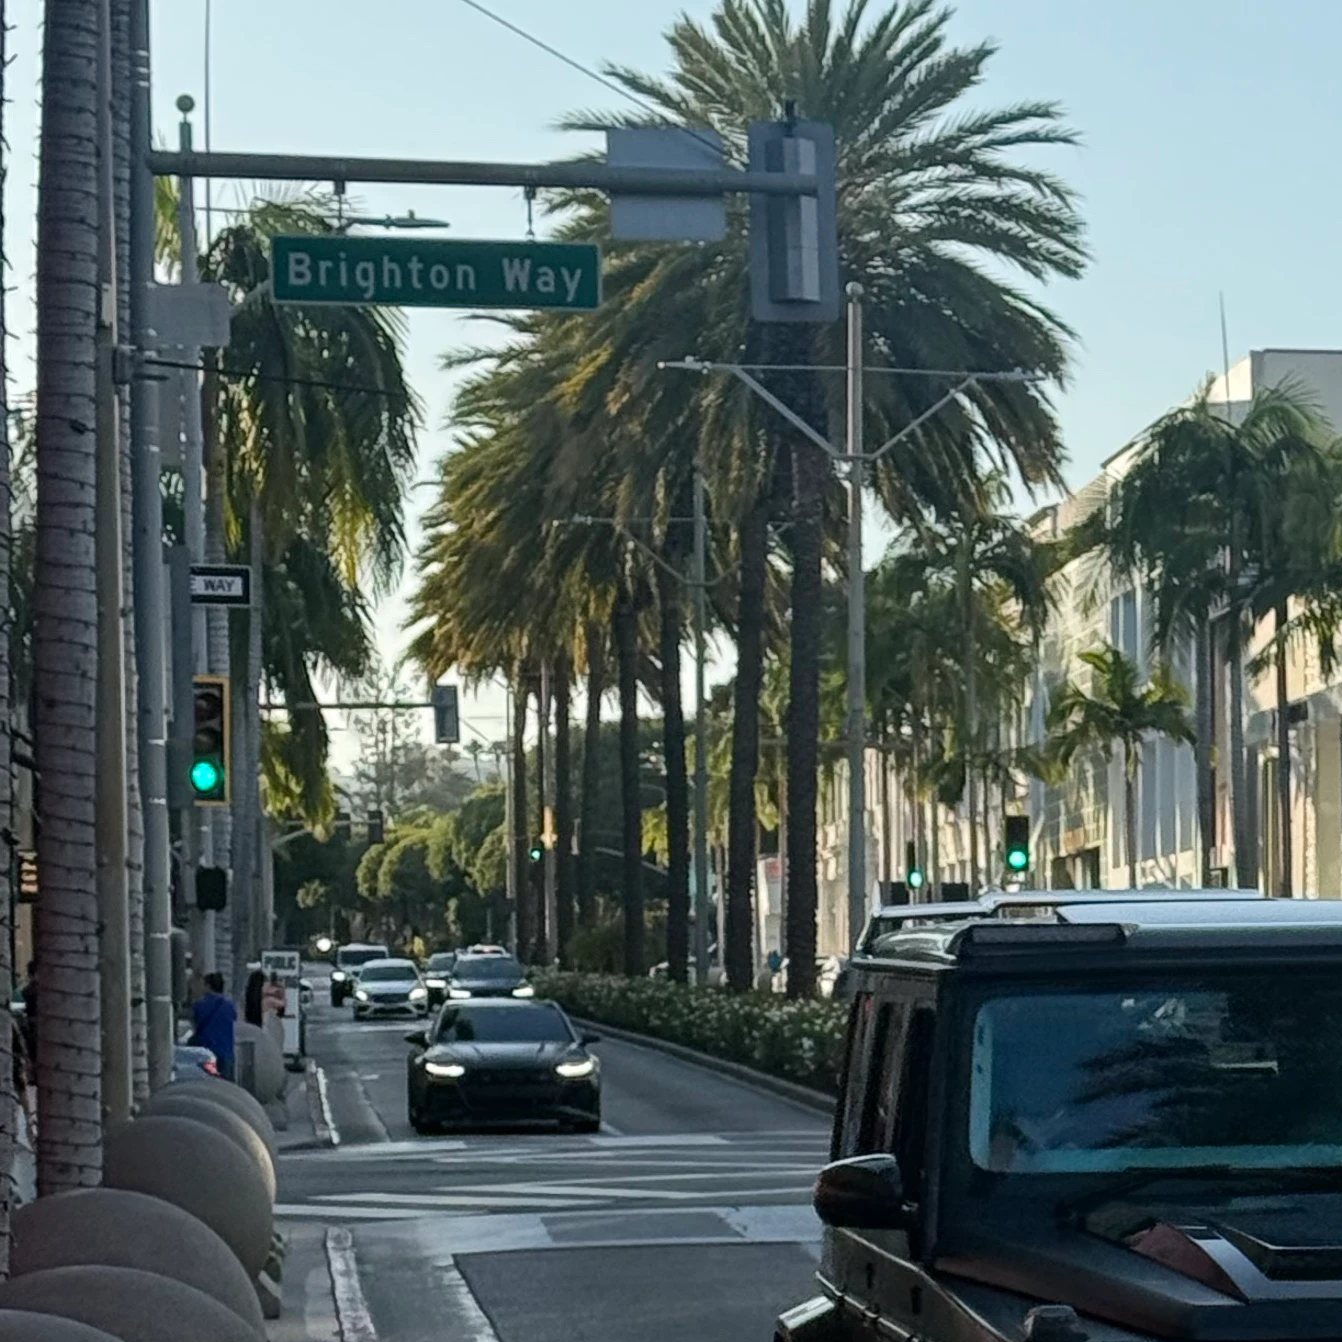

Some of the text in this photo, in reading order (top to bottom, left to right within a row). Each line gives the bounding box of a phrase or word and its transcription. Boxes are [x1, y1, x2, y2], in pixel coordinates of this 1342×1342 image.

[288, 251, 582, 302] Brighton Way
[203, 579, 235, 592] WAY
